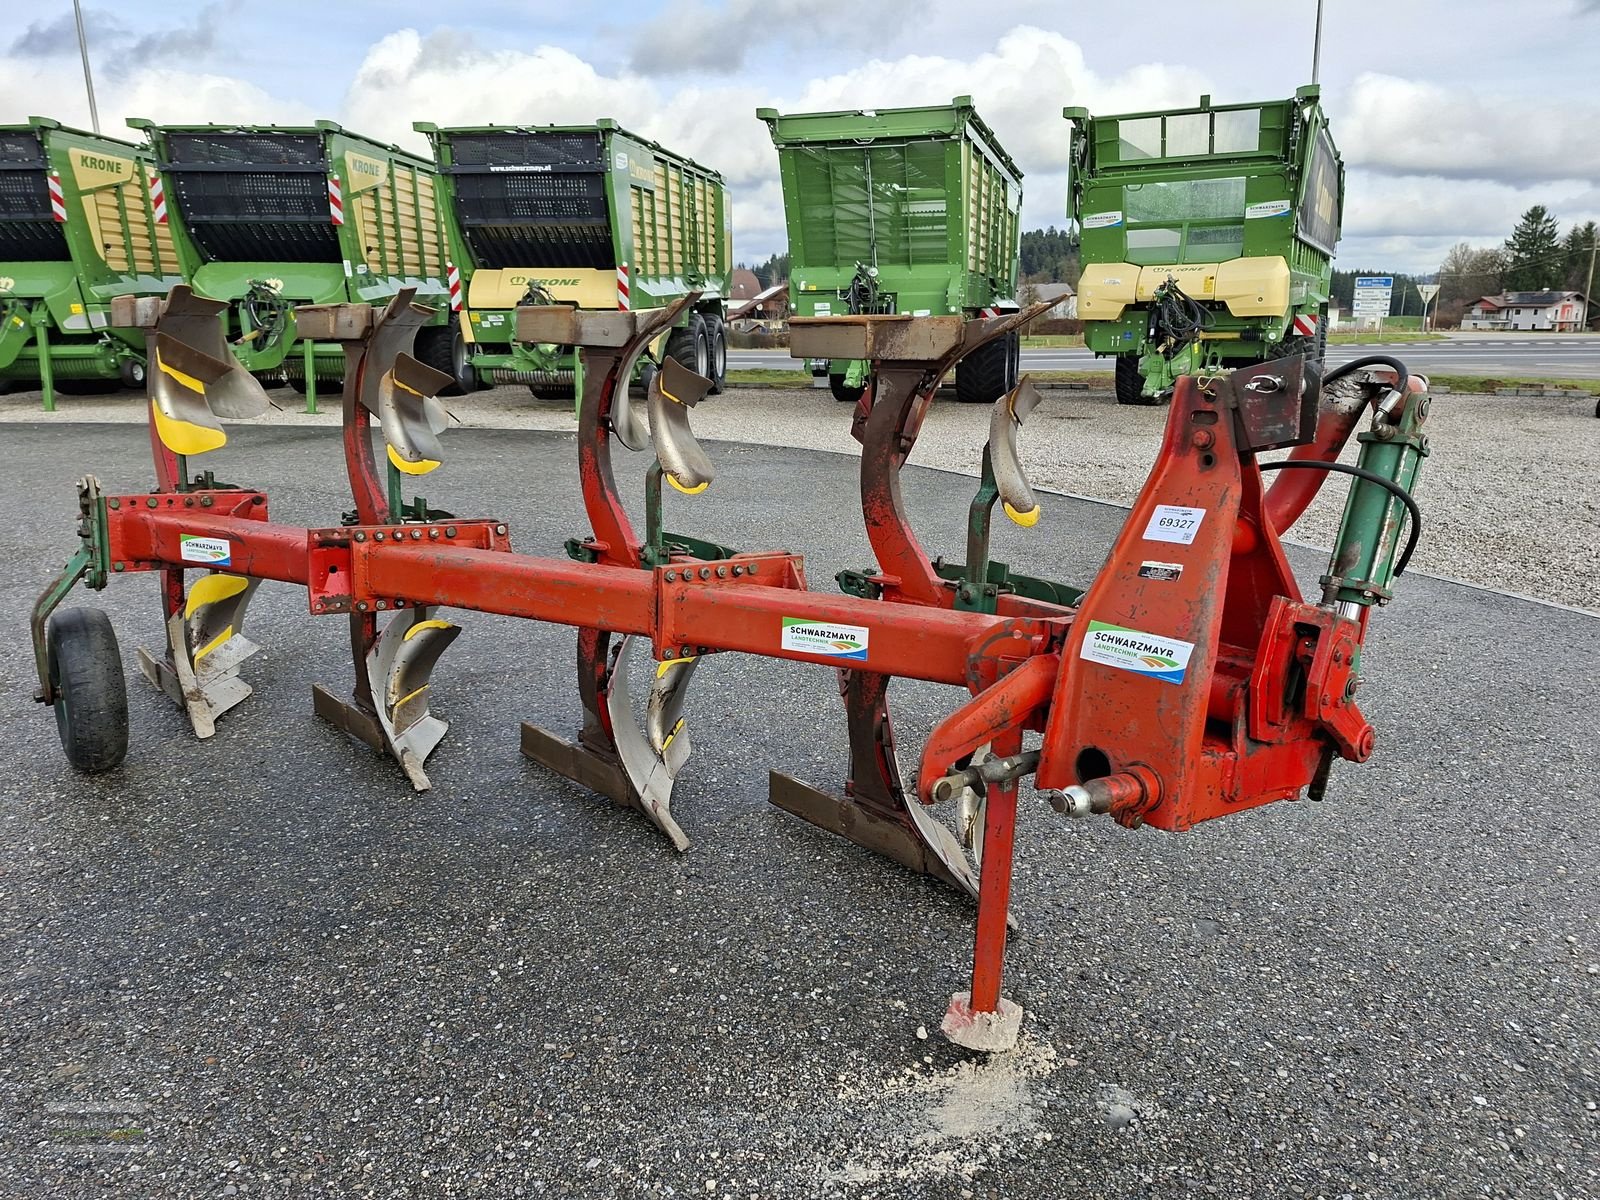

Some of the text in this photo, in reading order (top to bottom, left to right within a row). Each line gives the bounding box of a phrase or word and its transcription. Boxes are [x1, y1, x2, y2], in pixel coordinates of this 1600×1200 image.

[80, 154, 122, 173] KRONE
[352, 158, 380, 177] KRONE
[1159, 517, 1195, 529] 69327
[185, 541, 222, 551] SCHWARZMAYR
[790, 626, 856, 641] SCHWARZMAYR
[791, 635, 828, 644] LANDTECHNIK
[1093, 642, 1138, 659] LANDTECHNIK
[1094, 632, 1174, 658] SCHWARZMAYR
